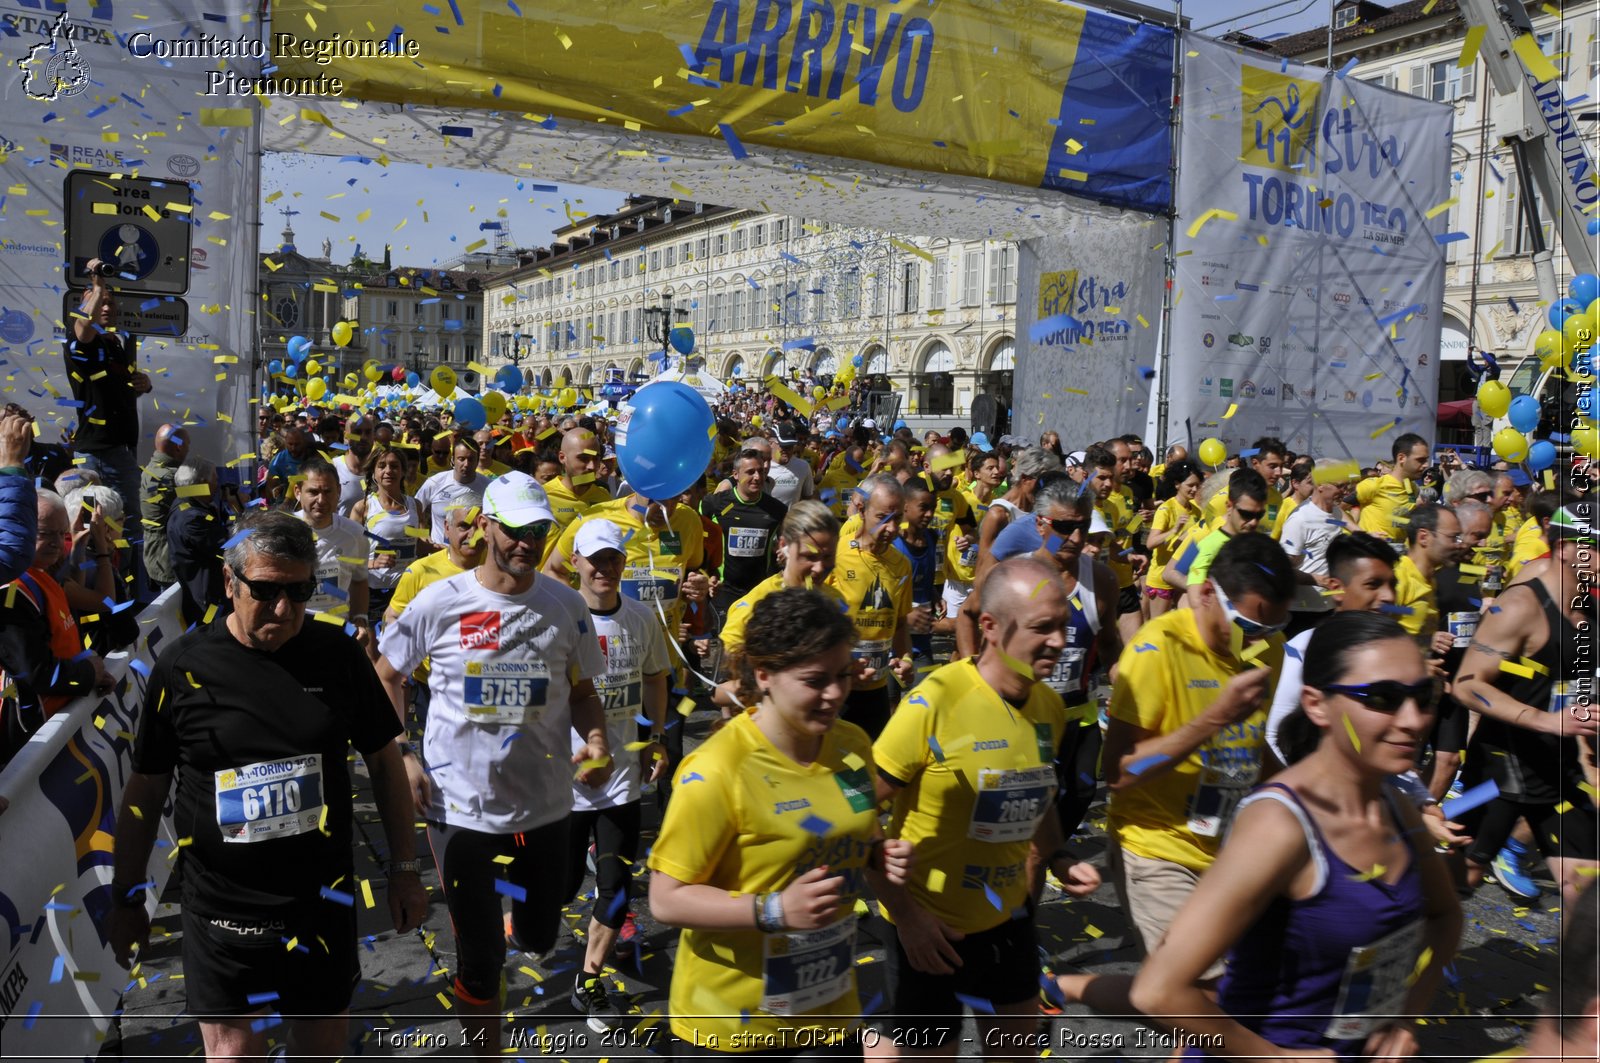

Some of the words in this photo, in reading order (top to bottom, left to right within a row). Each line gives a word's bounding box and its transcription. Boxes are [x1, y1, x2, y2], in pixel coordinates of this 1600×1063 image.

[693, 0, 935, 113] ARRIVO
[73, 145, 125, 160] REALE
[112, 187, 151, 200] area
[1242, 172, 1356, 238] TORINO
[2, 241, 56, 254] ondovicino
[855, 617, 885, 628] Allianz
[460, 626, 499, 650] CEDAS
[481, 678, 532, 706] 5755
[253, 760, 293, 778] TORINO
[242, 779, 302, 821] 6170
[998, 798, 1040, 823] 2605
[794, 956, 840, 988] 1222
